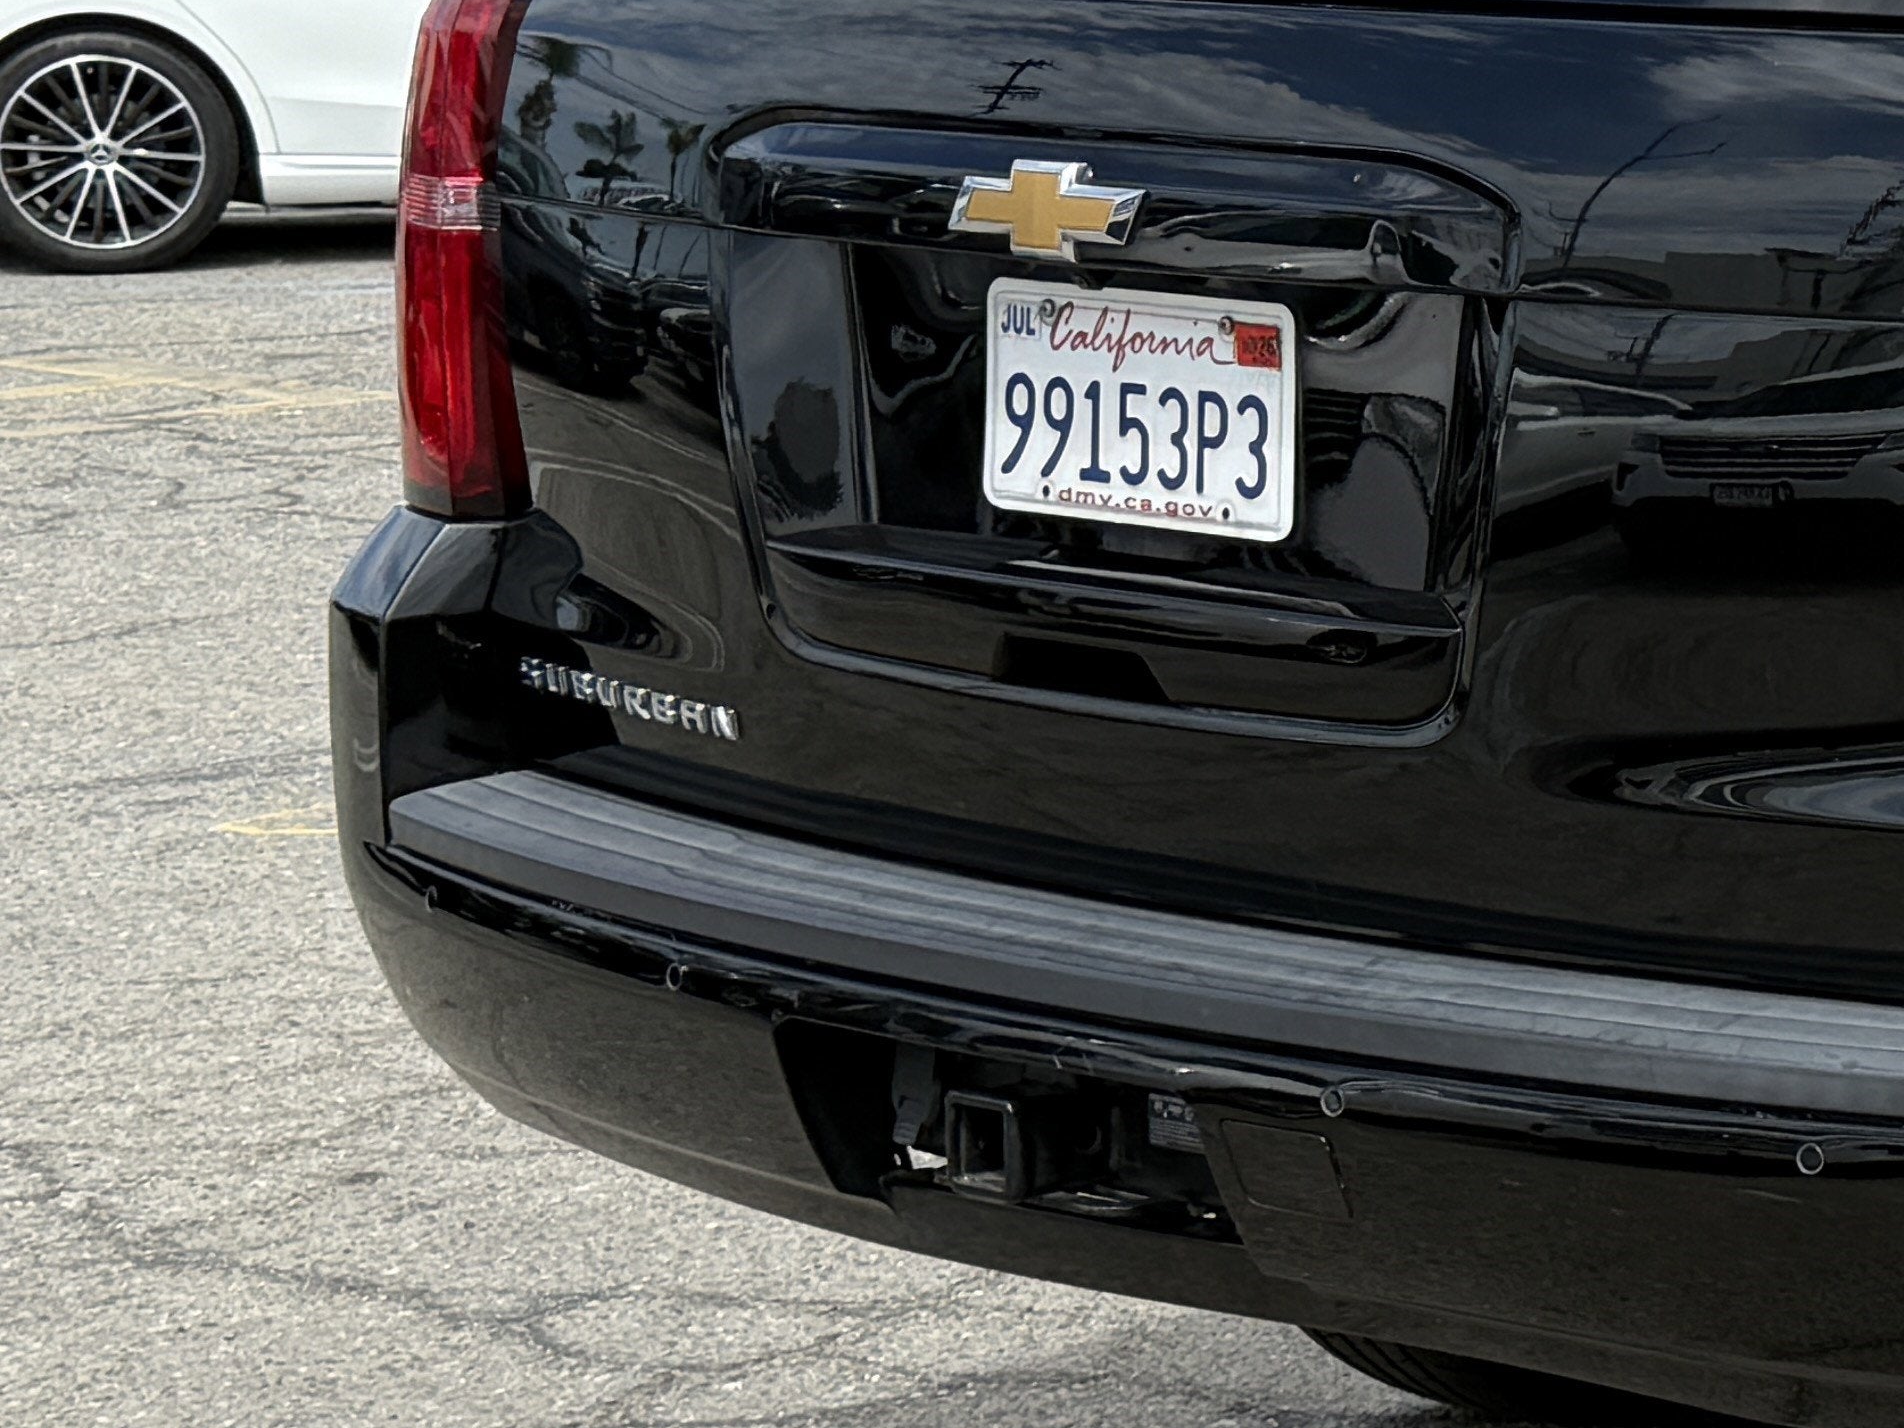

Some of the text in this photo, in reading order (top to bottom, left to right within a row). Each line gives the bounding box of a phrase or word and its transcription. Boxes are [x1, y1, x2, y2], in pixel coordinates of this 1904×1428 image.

[1001, 304, 1036, 336] JUL
[1050, 300, 1236, 373] California
[1001, 372, 1268, 500] 99153P3
[1058, 487, 1213, 517] dmv.ca.gov
